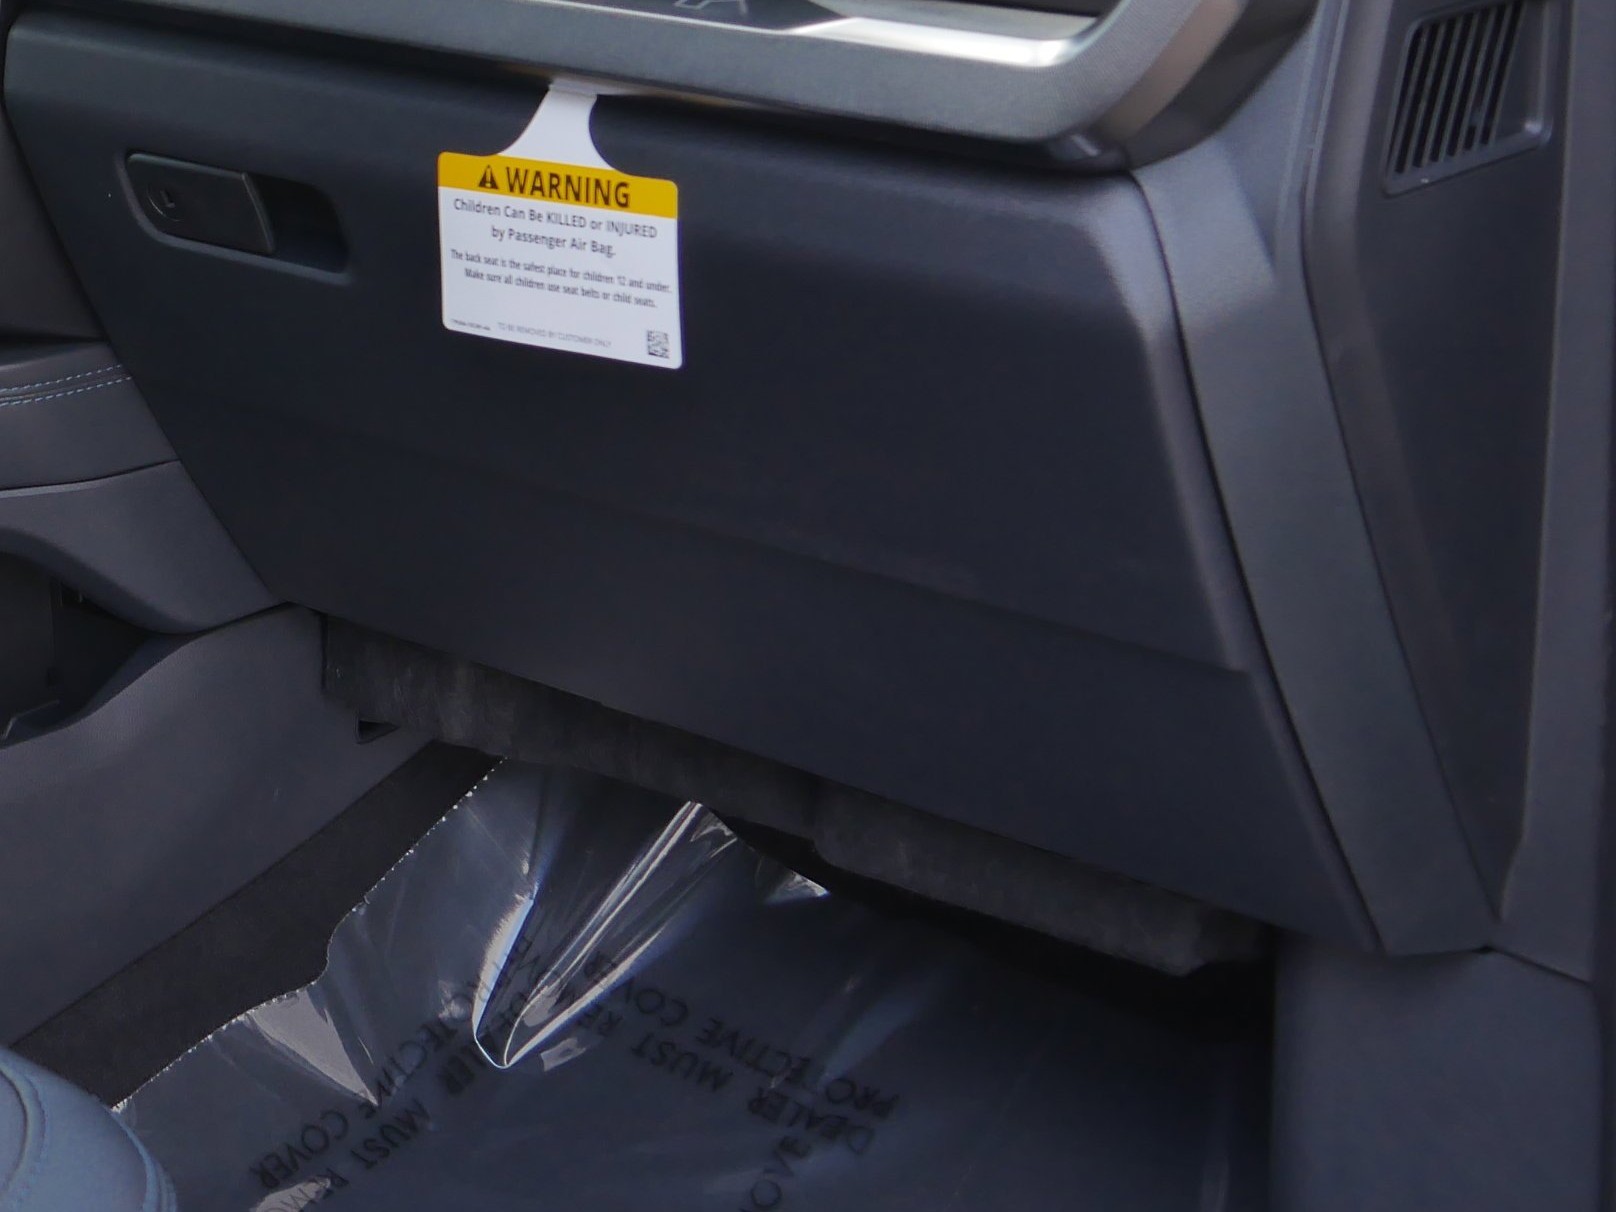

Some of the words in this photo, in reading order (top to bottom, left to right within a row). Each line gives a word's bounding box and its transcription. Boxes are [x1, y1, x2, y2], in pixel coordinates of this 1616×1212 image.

[505, 166, 631, 209] WARNING
[453, 198, 501, 216] Children
[504, 205, 526, 220] Can
[528, 209, 543, 223] Be
[547, 212, 587, 228] KILLED
[589, 220, 603, 230] or
[606, 220, 658, 238] INJURED
[491, 225, 506, 242] by
[508, 228, 567, 250] Passenger
[570, 237, 587, 250] Air
[591, 240, 616, 259] Bag.
[451, 248, 463, 260] The
[465, 252, 481, 264] back
[483, 256, 499, 267] seat
[501, 259, 507, 268] is
[509, 260, 521, 270] the
[523, 262, 545, 274] safest
[547, 266, 567, 278] place
[569, 268, 580, 279] for
[583, 271, 614, 284] children
[629, 278, 643, 289] and
[464, 267, 484, 280] Make
[486, 273, 502, 283] sure
[504, 274, 514, 285] all
[515, 277, 545, 290] children
[547, 283, 560, 293] use
[563, 284, 579, 296] seat
[581, 287, 600, 299] belts
[602, 291, 611, 300] or
[613, 291, 632, 304] child
[631, 1032, 734, 1093] MUST
[247, 1109, 349, 1190] COVER
[350, 1097, 432, 1171] MUST
